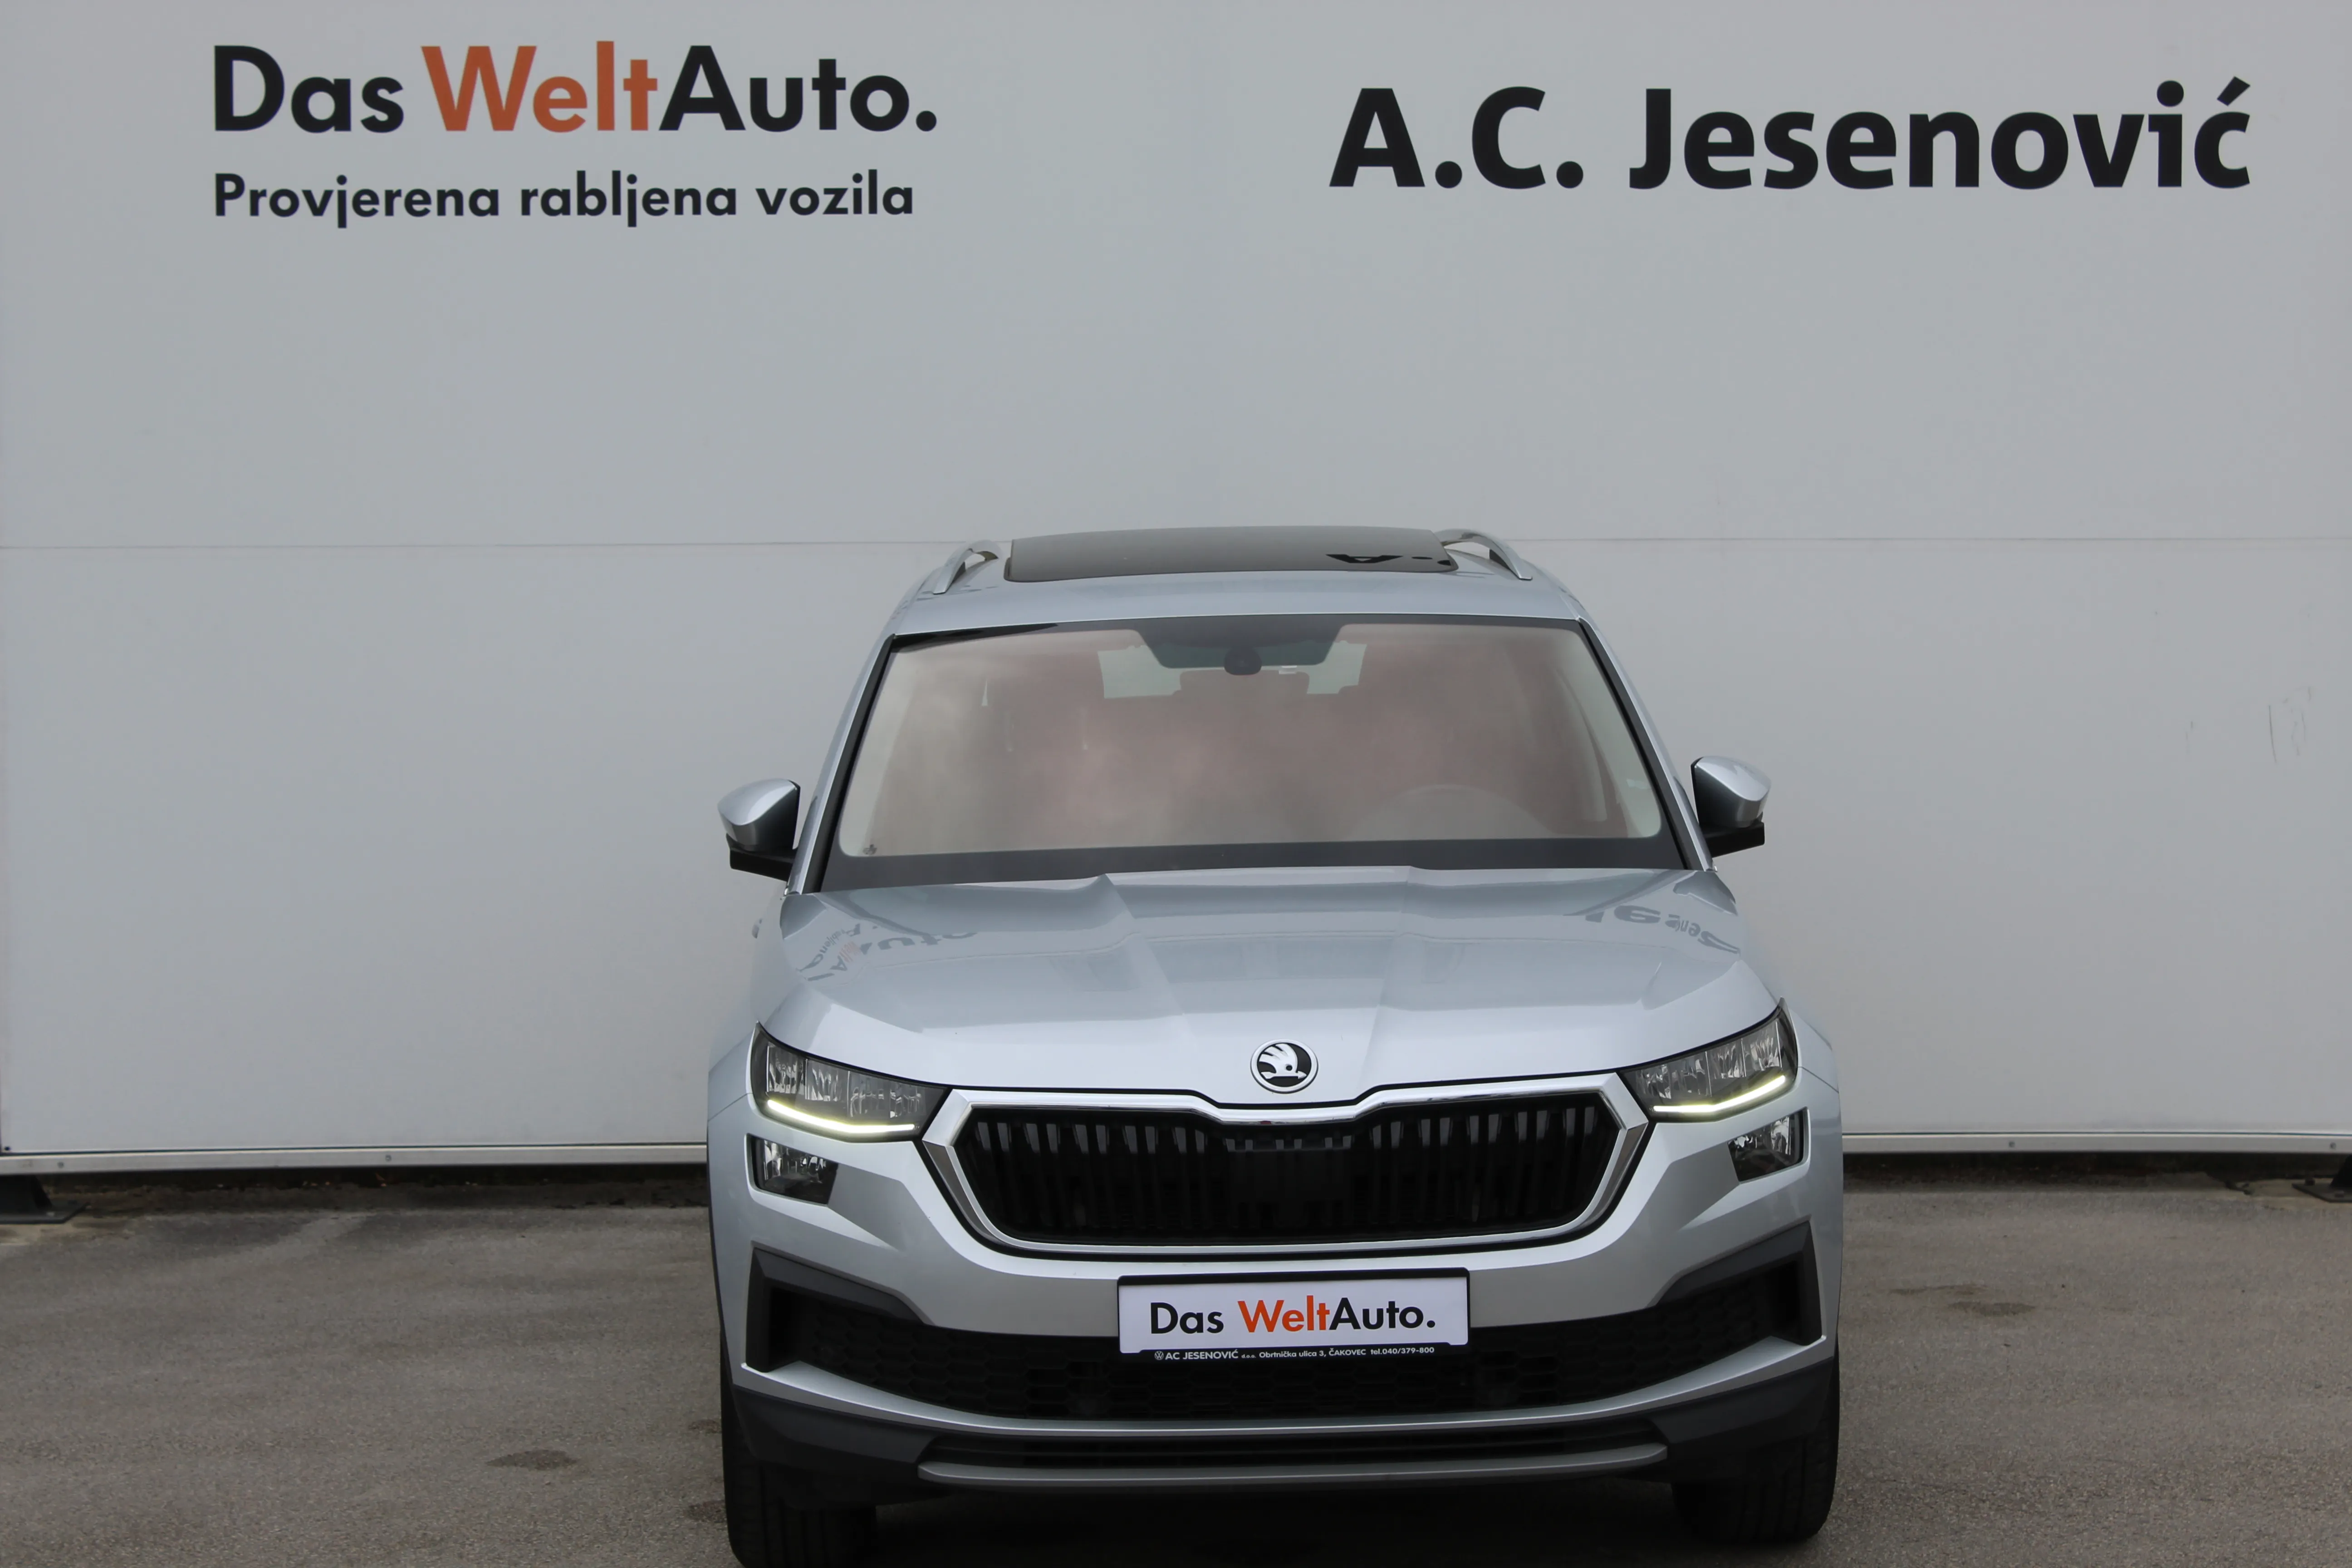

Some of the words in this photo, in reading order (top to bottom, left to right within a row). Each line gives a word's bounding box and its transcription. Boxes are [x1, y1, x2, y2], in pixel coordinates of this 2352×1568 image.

[215, 45, 403, 133] Das
[422, 41, 936, 132] WeltAuto.
[1330, 87, 1583, 189] A.C.
[1630, 77, 2250, 189] Jesenović
[216, 173, 498, 228] Provjerena
[522, 170, 736, 227] rabljena
[756, 169, 912, 215] vozila
[1151, 1302, 1224, 1333] Das
[1238, 1295, 1436, 1333] WeltAuto.
[1183, 1349, 1238, 1360] JESENOVIĆ
[1328, 1348, 1366, 1356] ČAKOVEC
